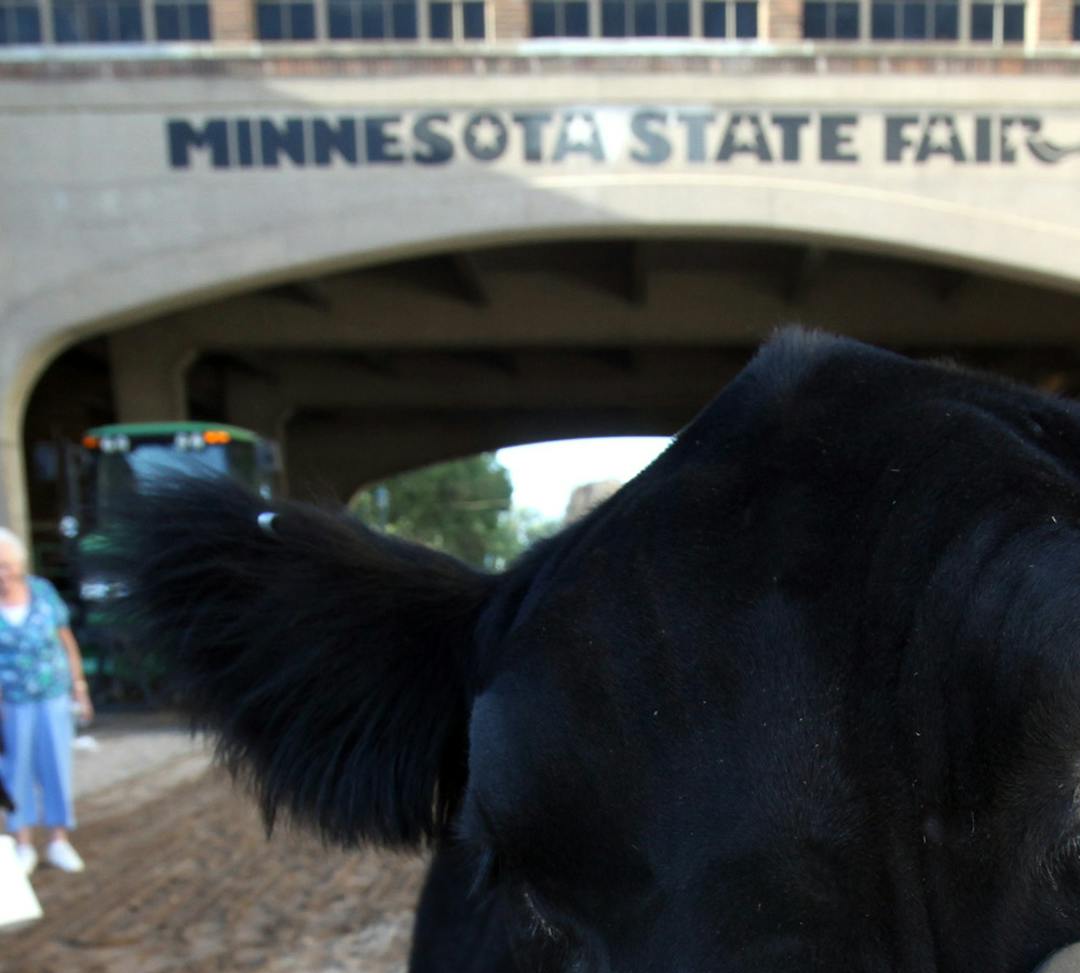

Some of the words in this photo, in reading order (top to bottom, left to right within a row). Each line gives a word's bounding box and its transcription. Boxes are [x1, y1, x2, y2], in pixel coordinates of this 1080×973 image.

[167, 110, 605, 168] MINNESOTA
[628, 109, 858, 164] STATE
[883, 114, 1064, 164] FAIR
